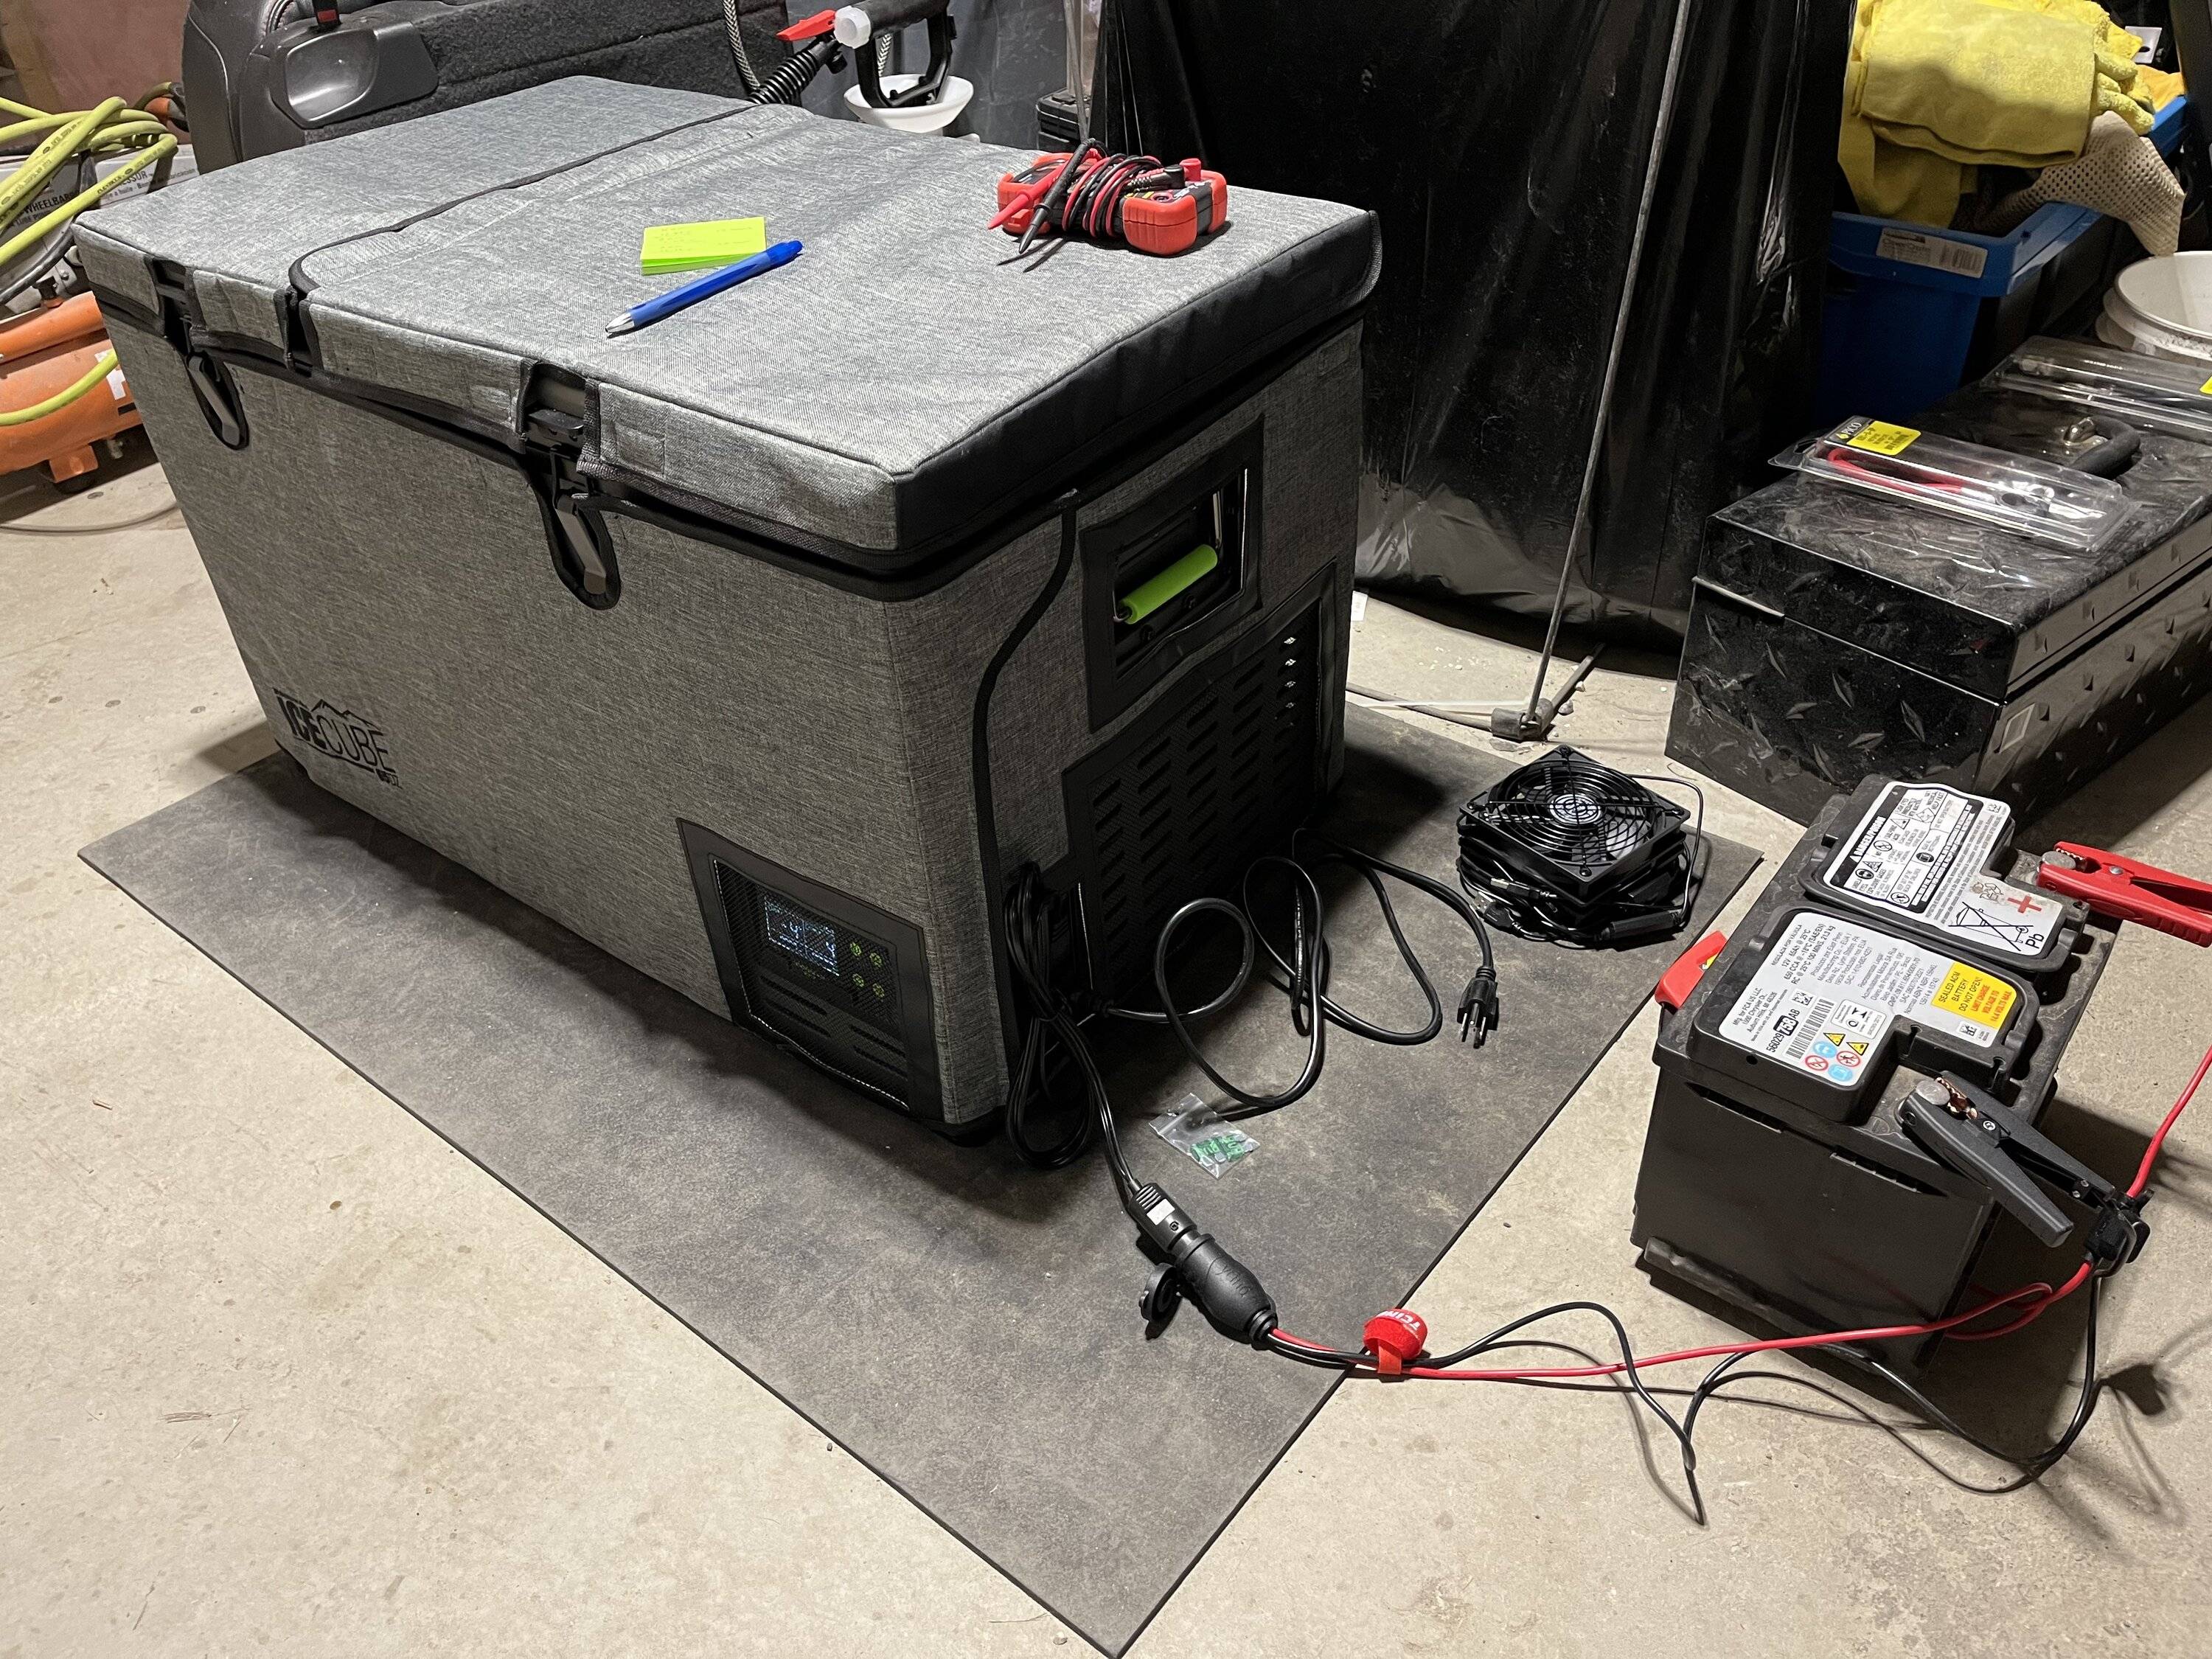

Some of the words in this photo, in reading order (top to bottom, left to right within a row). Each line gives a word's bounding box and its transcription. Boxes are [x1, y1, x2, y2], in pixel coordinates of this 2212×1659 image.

[2024, 930, 2045, 950] Pb
[1780, 957, 1792, 967] 12V
[1788, 959, 1801, 972] CCA
[1790, 975, 1801, 985] RC
[1937, 981, 1955, 1004] SEALED
[1949, 970, 1961, 983] AGM
[1950, 978, 1969, 1002] BATTERY
[1962, 991, 1974, 1004] NOT
[1742, 1001, 1752, 1011] FCA
[1958, 1002, 1968, 1012] DO
[1981, 995, 1997, 1015] VOLTAGE
[1765, 1032, 1785, 1053] 56029
[1787, 1007, 1800, 1019] AB
